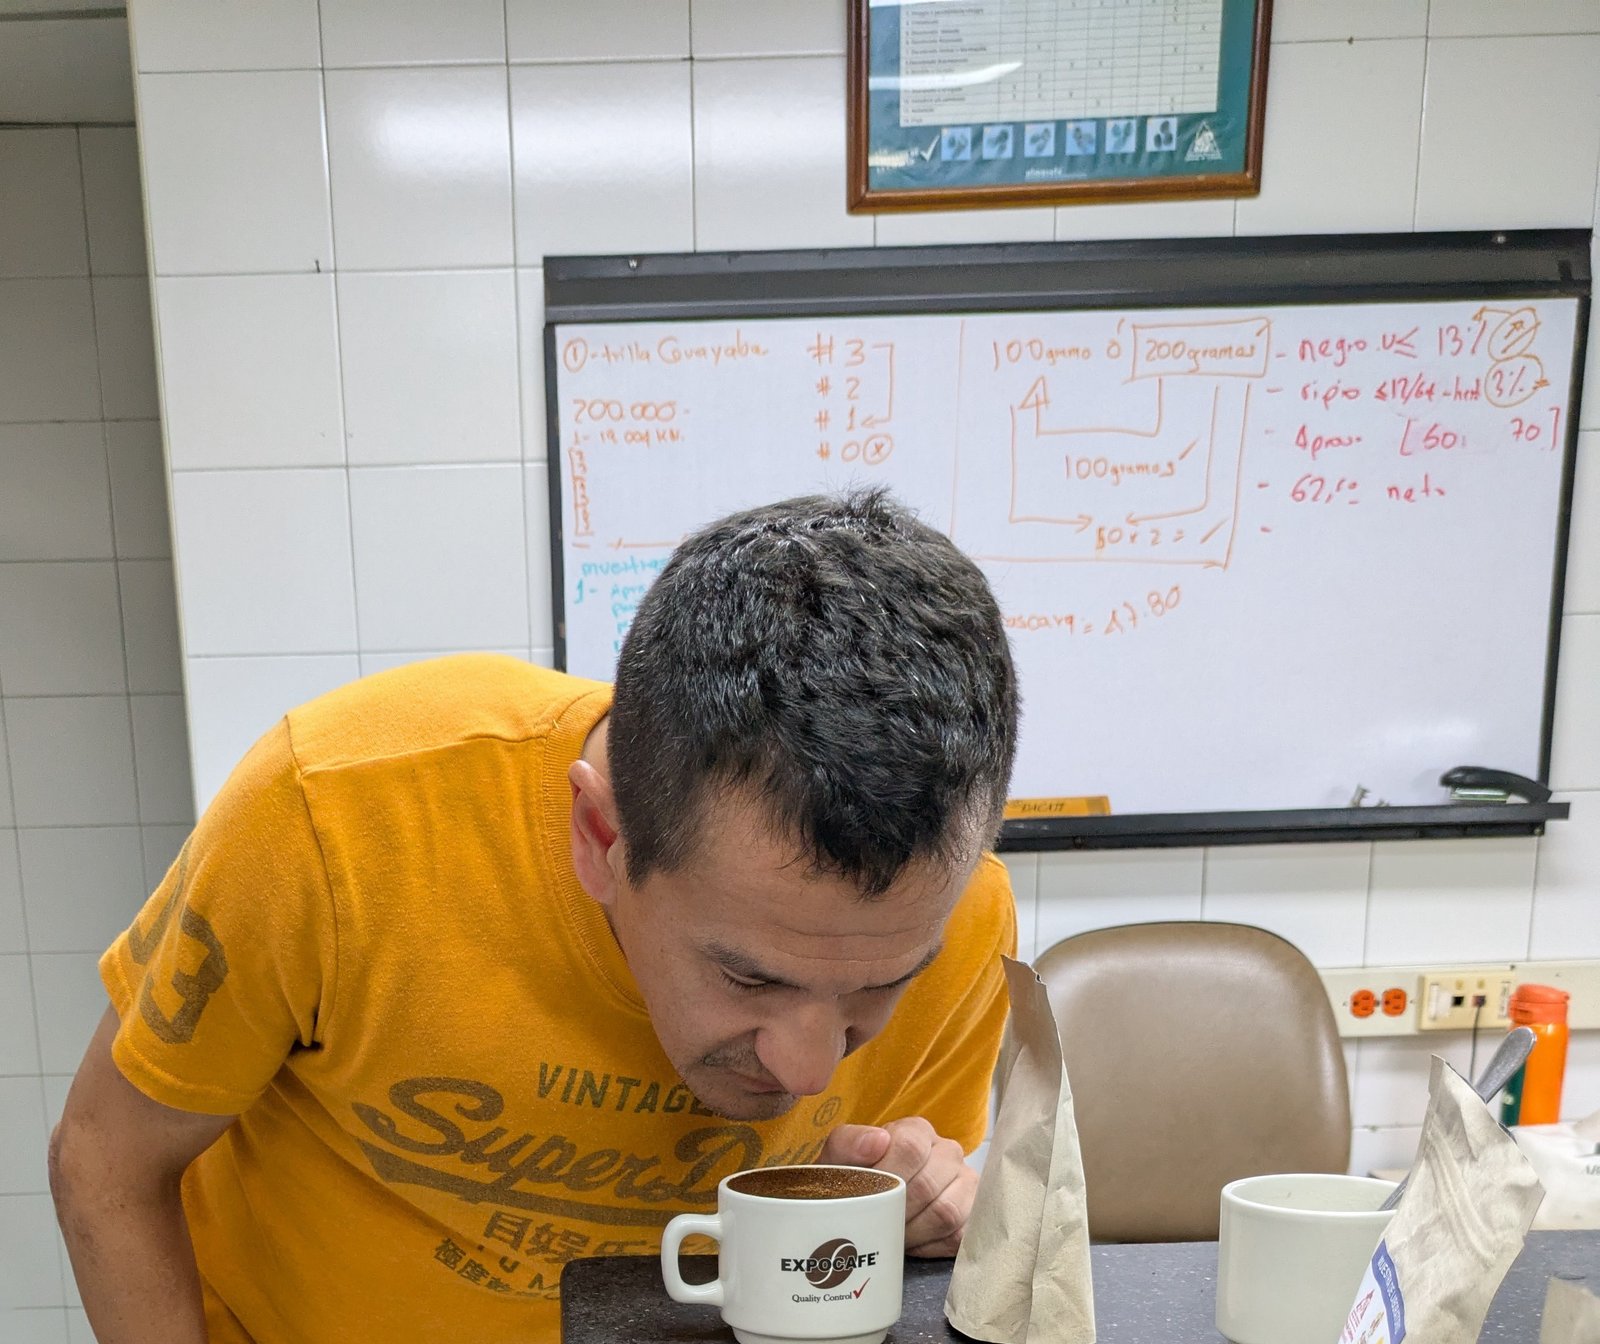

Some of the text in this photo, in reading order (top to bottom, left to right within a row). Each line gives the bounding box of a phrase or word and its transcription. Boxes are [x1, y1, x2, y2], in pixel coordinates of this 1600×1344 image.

[843, 338, 866, 367] 3
[846, 378, 861, 401] 2
[352, 1076, 828, 1204] SuperD
[792, 1291, 852, 1304] Quality Control
